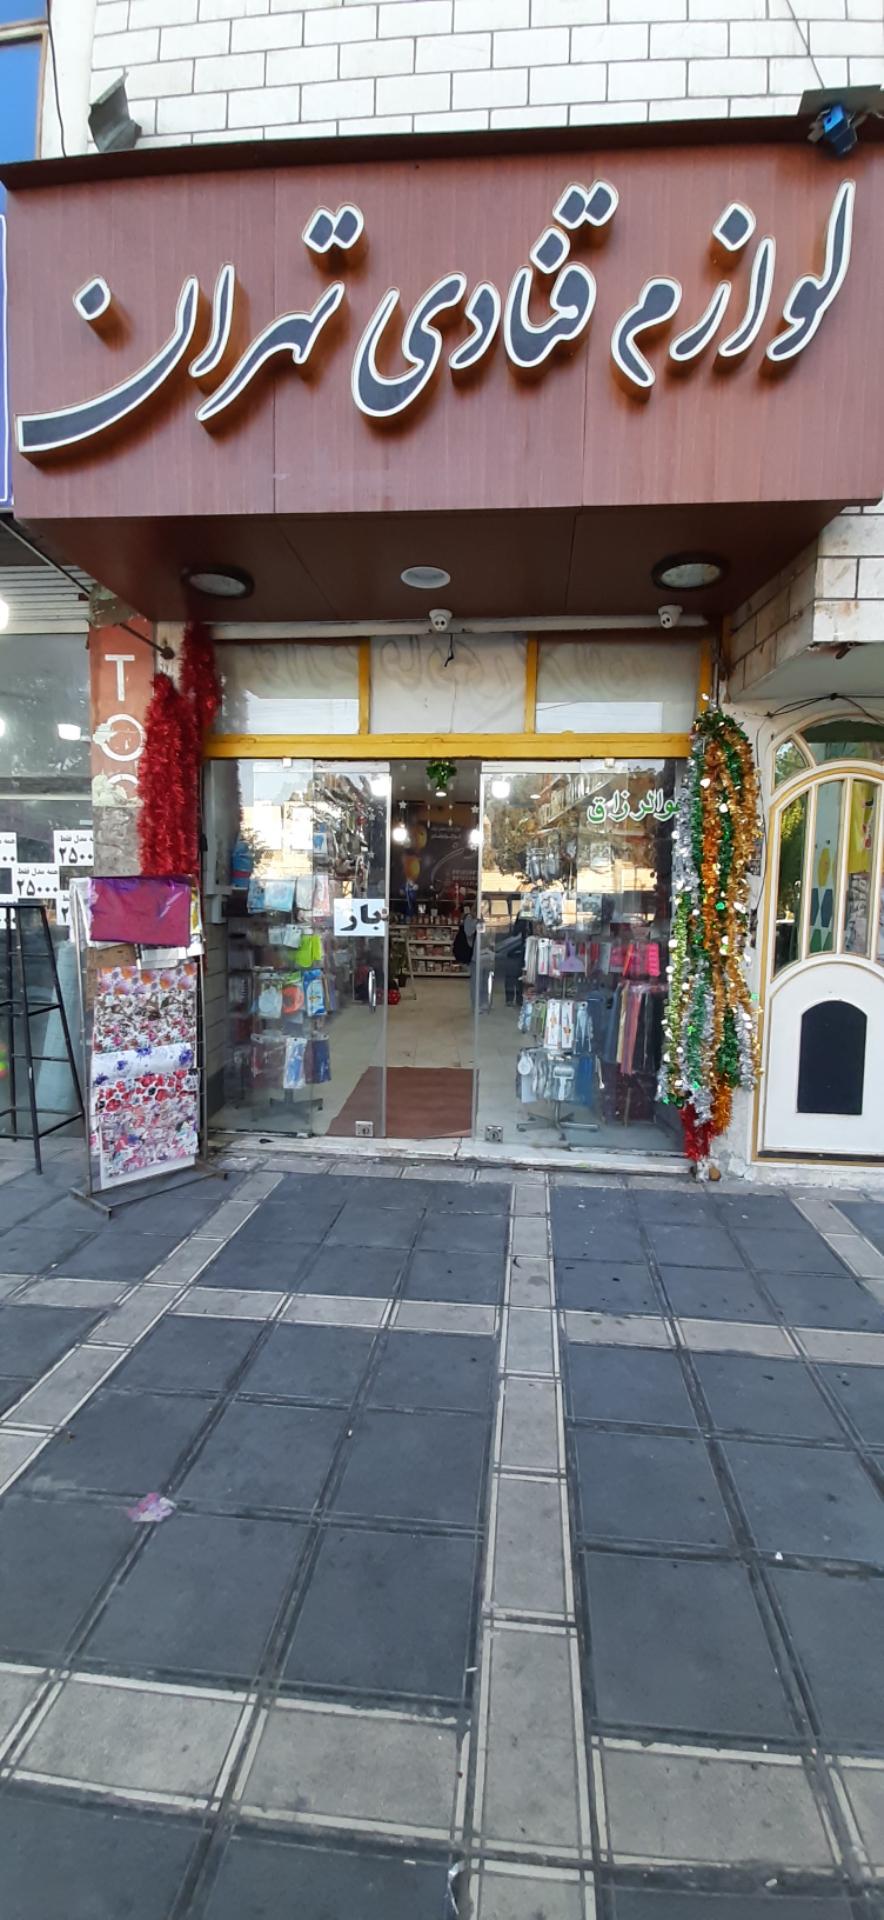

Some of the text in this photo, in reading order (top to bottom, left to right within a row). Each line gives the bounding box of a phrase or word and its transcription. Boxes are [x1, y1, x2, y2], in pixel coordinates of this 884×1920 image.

[13, 179, 857, 453] لوازم قنادی تهران
[16, 879, 58, 897] ۲۵۰۰۰
